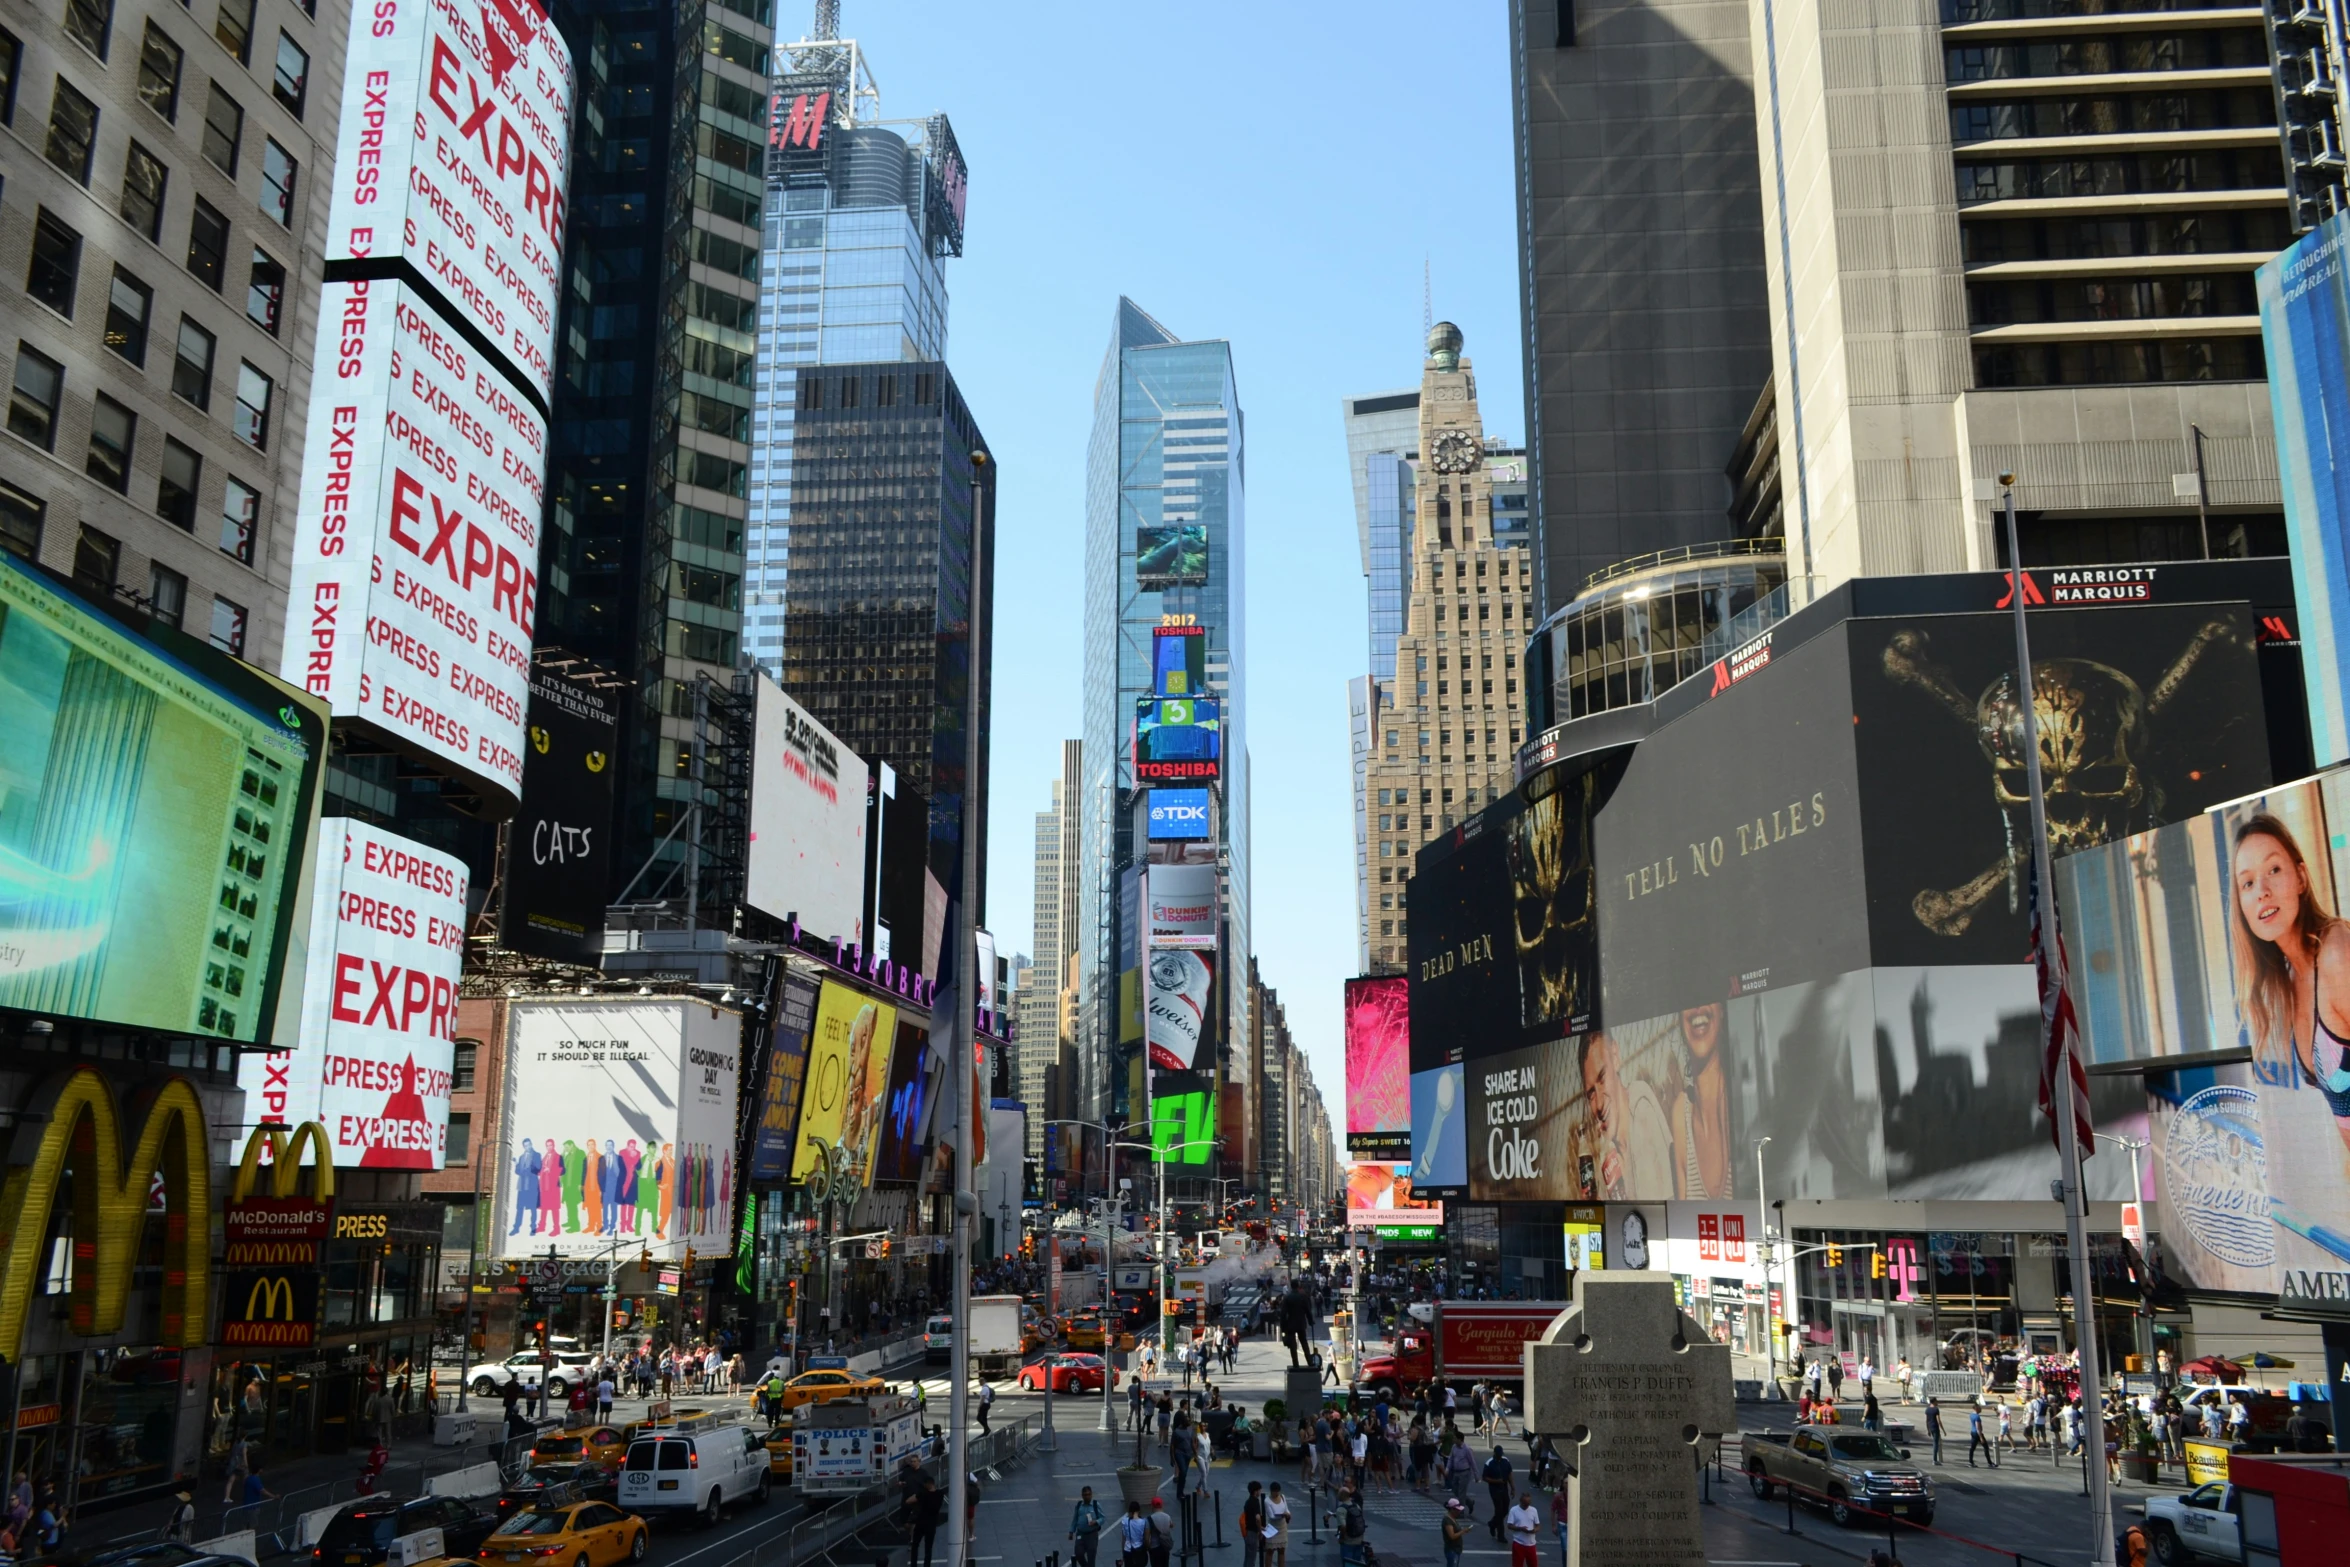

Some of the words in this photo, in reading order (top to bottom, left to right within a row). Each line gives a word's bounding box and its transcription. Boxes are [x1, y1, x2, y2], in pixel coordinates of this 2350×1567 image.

[501, 75, 564, 172] EXPRESS
[354, 70, 389, 205] EXPRESS
[437, 136, 514, 239] EXPRESS
[2283, 233, 2346, 283] RETOUCHING
[427, 239, 505, 336] EXPRESS
[485, 243, 551, 335] EXPRESS
[412, 375, 494, 457] EXPRESS
[476, 372, 542, 454] EXPRESS
[320, 405, 357, 557] EXPRESS
[467, 473, 535, 548] EXPRESS
[2052, 567, 2157, 583] MARRIOTT
[2055, 584, 2147, 600] MARQUIS
[394, 569, 478, 644] EXPRESS
[1154, 627, 1204, 636] TOSHIBA
[1162, 614, 1196, 626] 2017
[1731, 632, 1774, 665] MARRIOTT
[1731, 648, 1770, 683] MARQUIS
[451, 664, 522, 730] EXPRESS
[529, 682, 562, 704] BETTER
[564, 697, 589, 715] THAN
[542, 675, 559, 690] IT'S
[561, 682, 584, 701] BACK
[585, 694, 604, 708] AND
[383, 686, 469, 752] EXPRESS
[1523, 730, 1560, 756] MARRIOTT
[1351, 701, 1367, 813] PEOPLE
[1523, 746, 1556, 770] MARQUIS
[1138, 763, 1218, 777] TOSHIBA
[1164, 807, 1205, 819] TDK
[533, 819, 592, 865] CATS
[1625, 867, 1679, 901] TELL
[1689, 836, 1725, 877] NO
[1736, 791, 1827, 858] TALES
[364, 840, 453, 897] EXPRESS
[1168, 905, 1211, 914] DUNKIN'
[1168, 914, 1209, 922] DONUTS
[1421, 949, 1455, 983] DEAD
[1461, 933, 1494, 965] MEN
[1741, 968, 1770, 982] MARRIOTT
[1742, 979, 1768, 992] MARQUIS
[824, 1016, 840, 1042] FEEL
[537, 1052, 547, 1061] IT
[551, 1052, 590, 1061] SHOULD
[592, 1052, 605, 1061] BE
[559, 1040, 573, 1049] SO
[578, 1040, 606, 1049] MUCH
[610, 1040, 629, 1049] FUN
[689, 1047, 734, 1072] GROUNDHOG
[772, 1051, 804, 1079] COME
[704, 1067, 718, 1085] DAY
[806, 1051, 854, 1121] JOY
[1485, 1070, 1519, 1097] SHARE
[1519, 1066, 1536, 1090] AN
[762, 1102, 797, 1130] AWAY
[1487, 1100, 1504, 1125] ICE
[1506, 1095, 1538, 1123] COLD
[338, 1115, 433, 1151] EXPRESS
[228, 1210, 325, 1225] McDonald's
[1724, 1221, 1741, 1237] UNI
[243, 1226, 308, 1236] Restaurant
[1411, 1229, 1432, 1237] NEW
[1725, 1242, 1744, 1260] QLO
[1457, 1321, 1515, 1343] Gargiulo
[1580, 1364, 1635, 1373] LIEUTENANT
[1639, 1364, 1685, 1373] COLONEL
[1573, 1377, 1629, 1389] FRANCIS
[1648, 1377, 1695, 1389] DUFFY
[1581, 1394, 1598, 1402] MAY
[1589, 1410, 1639, 1420] CATHOLIC
[1645, 1410, 1680, 1420] PRIEST
[812, 1429, 868, 1439] POLICE
[1612, 1436, 1660, 1445] CHAPLAIN
[1604, 1464, 1624, 1473] OLD
[2188, 1451, 2227, 1470] Beautiful
[1605, 1491, 1624, 1500] LIFE
[1628, 1491, 1641, 1499] OF
[1646, 1490, 1686, 1500] SERVICE
[1591, 1511, 1614, 1520] GOD
[1618, 1511, 1639, 1520] AND
[1642, 1511, 1689, 1520] COUNTRY
[1589, 1538, 1624, 1546] SPANISH
[1626, 1538, 1671, 1546] AMERICAN
[1673, 1538, 1693, 1546] WAR
[1580, 1551, 1598, 1559] NEW
[1601, 1551, 1624, 1559] YORK
[1628, 1551, 1670, 1559] NATIONAL
[1673, 1551, 1704, 1559] GUARD
